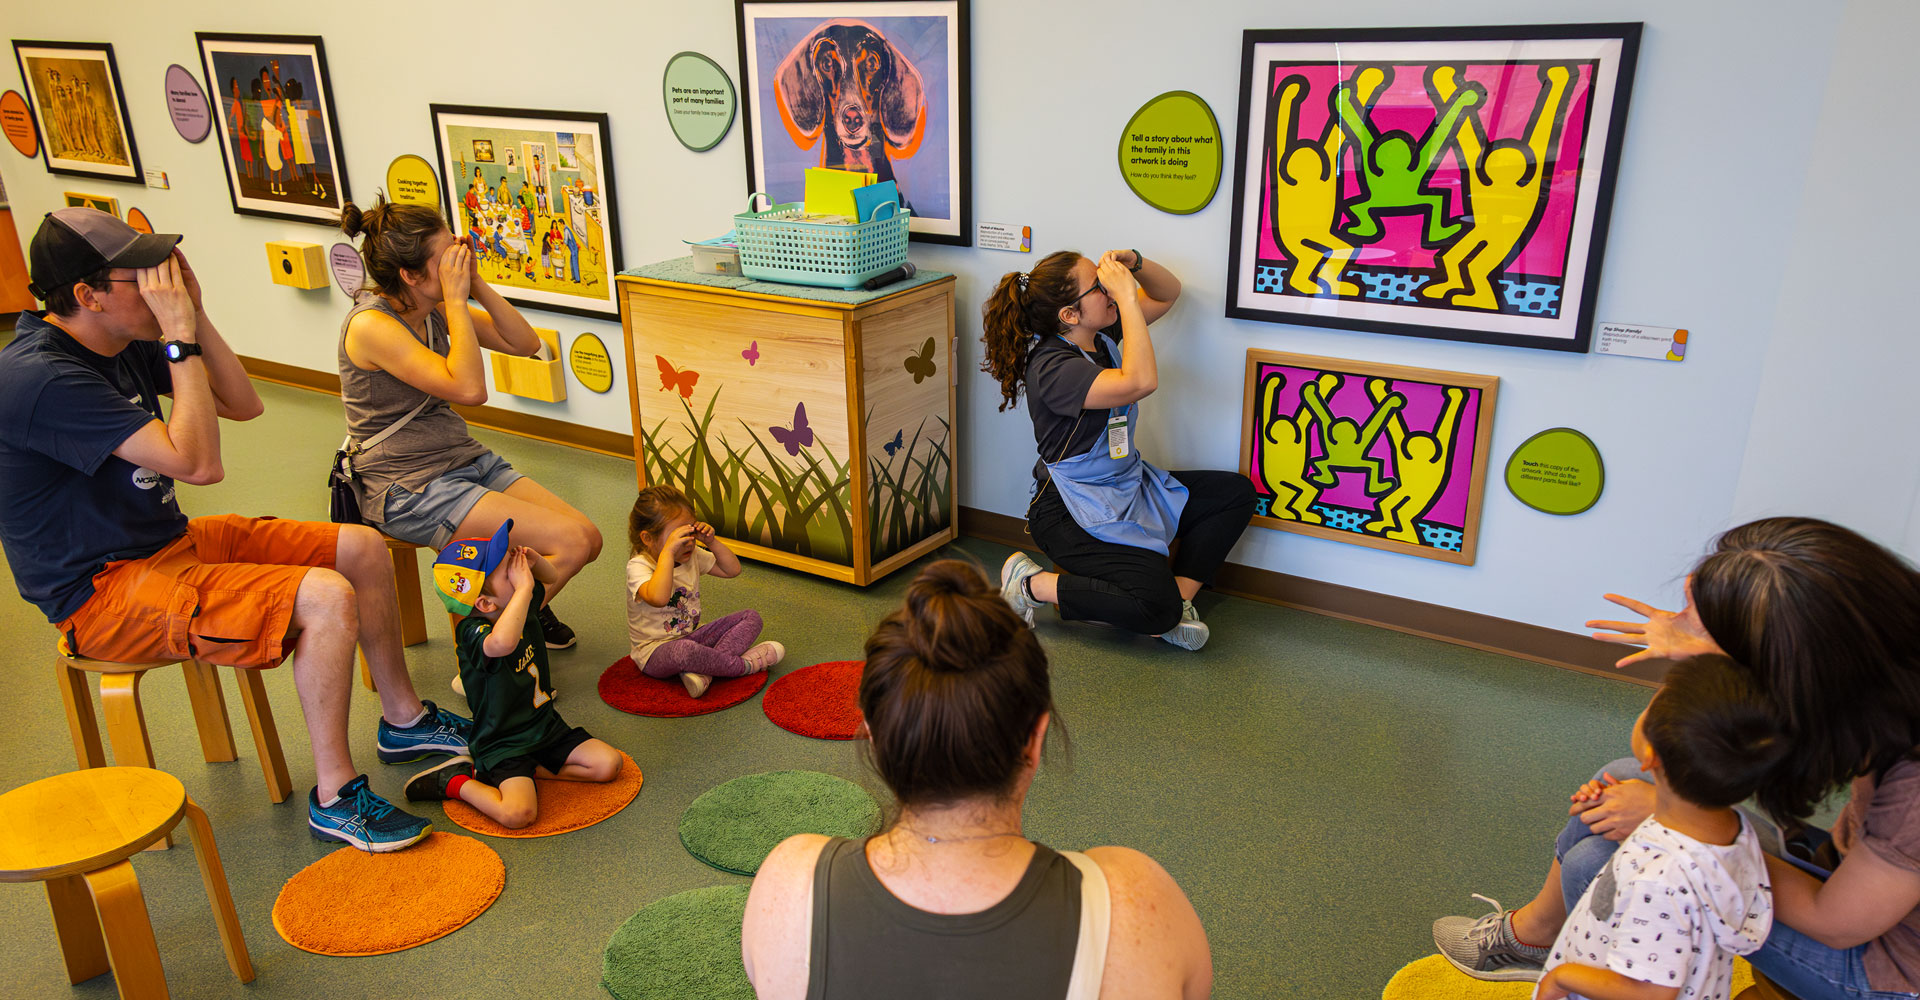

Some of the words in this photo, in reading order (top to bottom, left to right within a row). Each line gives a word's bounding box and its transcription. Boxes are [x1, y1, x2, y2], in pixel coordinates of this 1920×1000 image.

[1152, 135, 1169, 144] story
[1144, 146, 1167, 155] family
[1168, 158, 1188, 167] doing
[516, 644, 535, 672] JAKE
